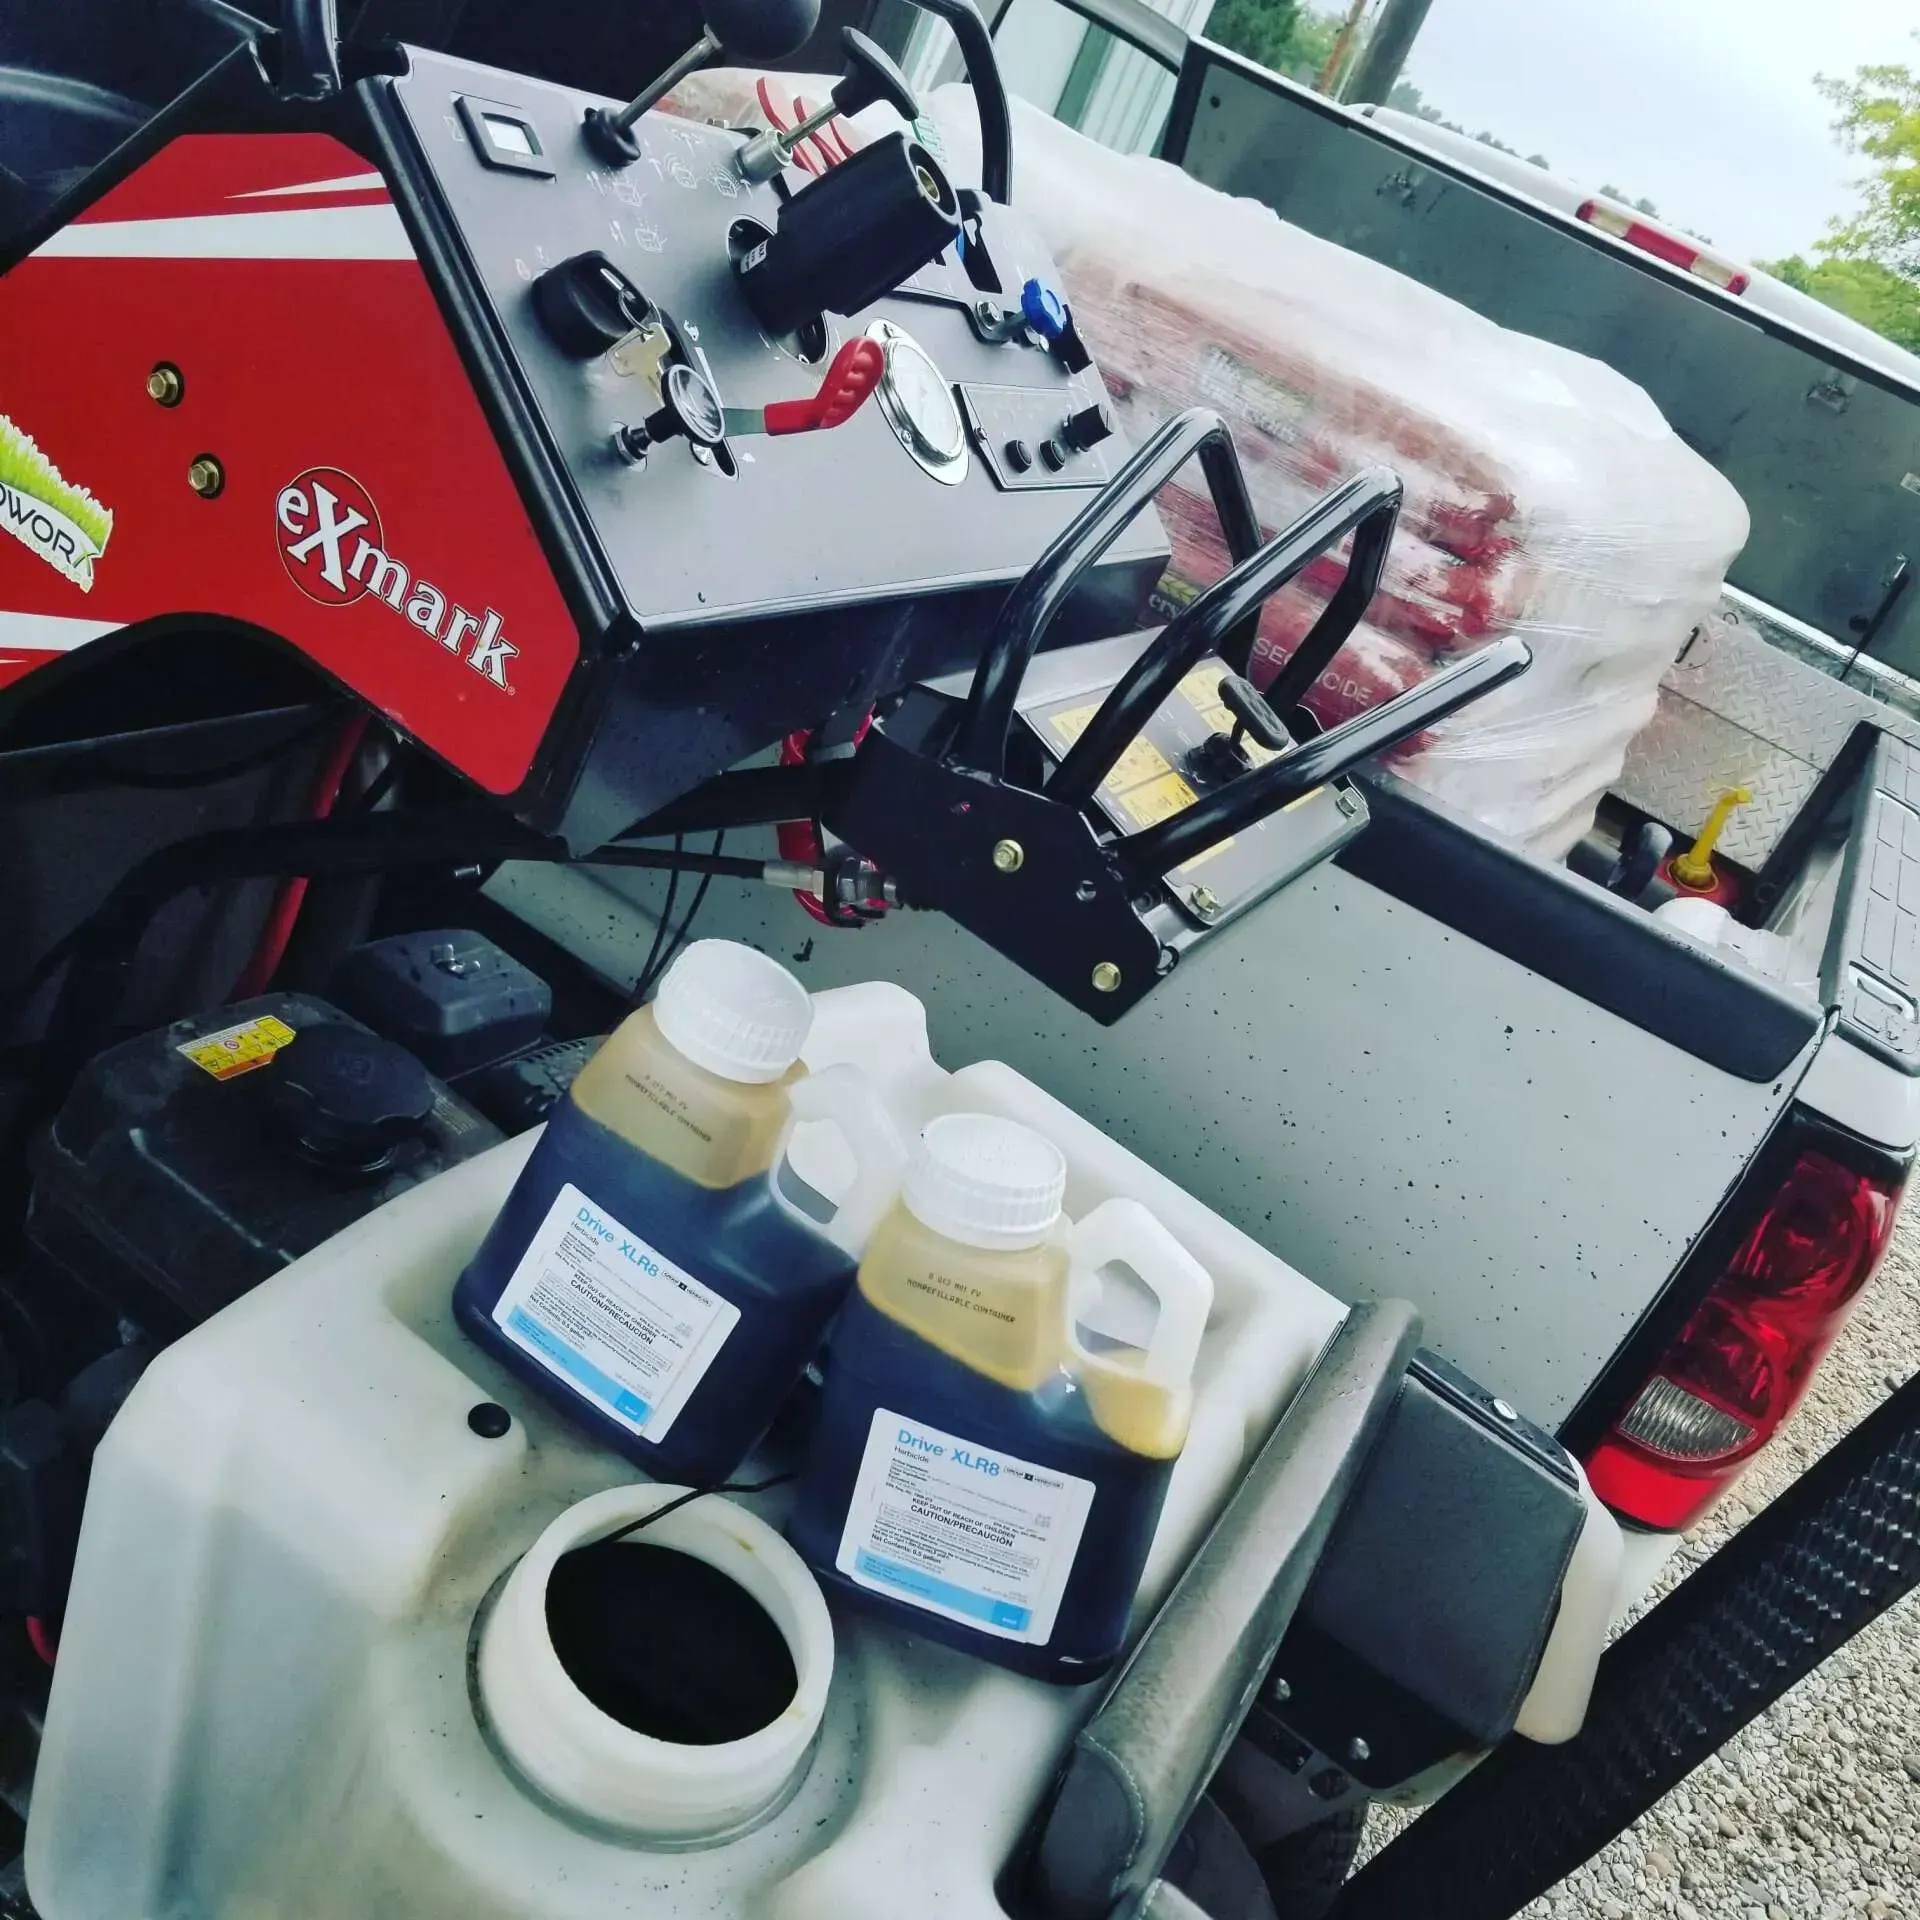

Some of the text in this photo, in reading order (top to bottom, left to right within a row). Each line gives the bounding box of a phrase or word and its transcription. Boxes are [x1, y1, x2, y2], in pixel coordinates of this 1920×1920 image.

[576, 1207, 616, 1243] Drive
[617, 1239, 660, 1277] XLR8
[574, 1273, 587, 1285] KEEP
[898, 1429, 944, 1456] Drive
[951, 1448, 1000, 1476] XLR8
[871, 1533, 882, 1541] Net
[912, 1497, 928, 1507] KEEP
[929, 1503, 941, 1511] OUT
[952, 1512, 974, 1524] REACH
[984, 1523, 1015, 1539] CHILDREN
